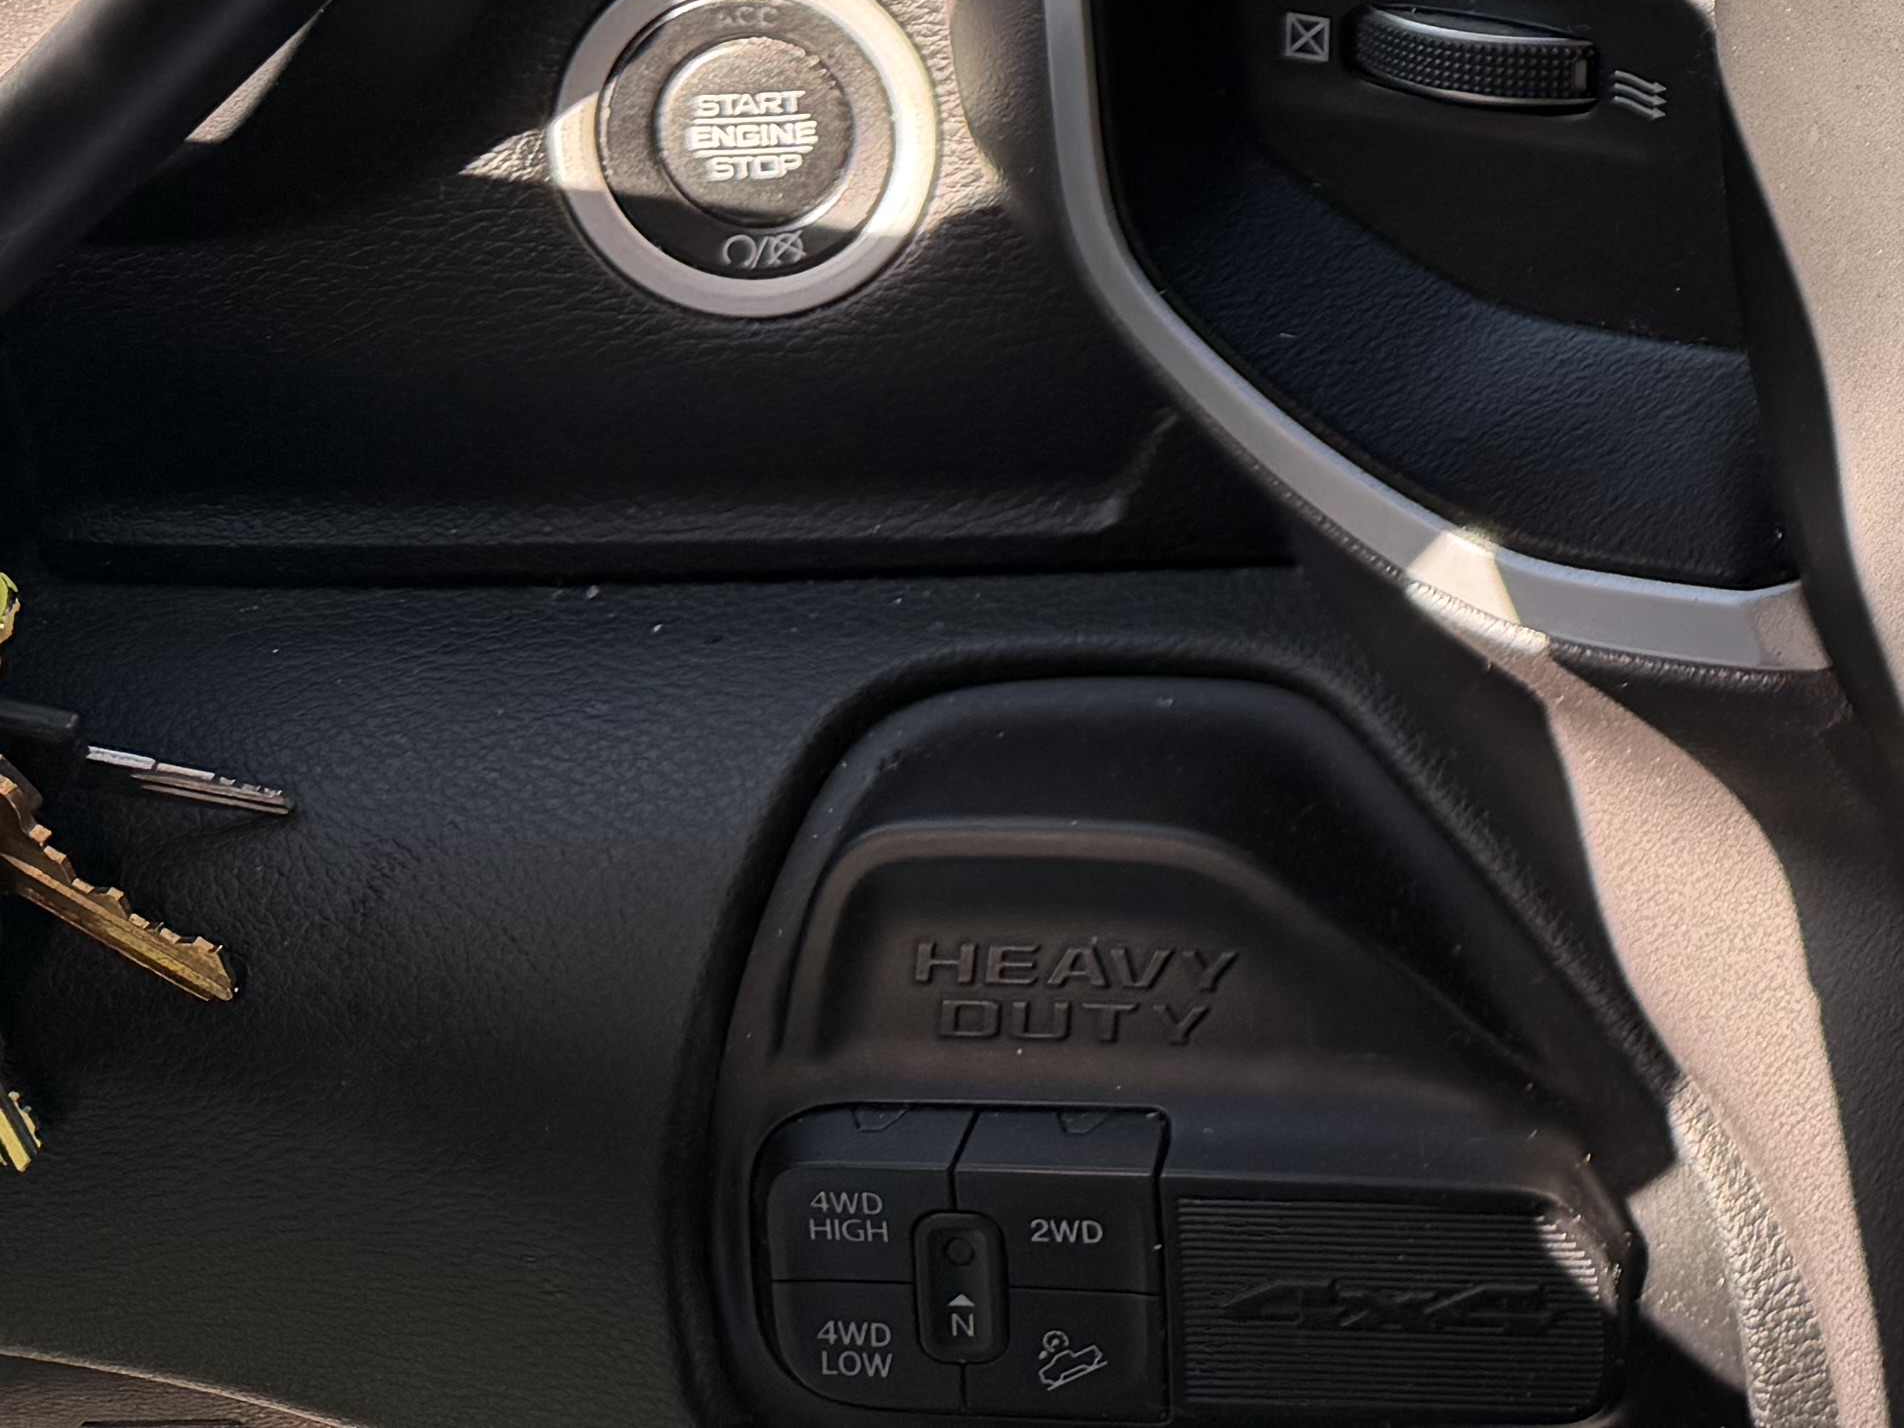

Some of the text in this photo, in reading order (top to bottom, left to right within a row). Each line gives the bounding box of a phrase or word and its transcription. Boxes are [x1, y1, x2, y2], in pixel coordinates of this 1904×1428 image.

[696, 90, 806, 117] START
[688, 120, 818, 150] ENGINE
[706, 154, 802, 181] STOP
[915, 943, 1238, 991] HEAVY
[939, 1000, 1209, 1045] DUTY
[810, 1191, 883, 1216] 4WD
[809, 1218, 889, 1243] HIGH
[1030, 1219, 1103, 1244] 2WD
[817, 1320, 892, 1347] 4WD
[951, 1312, 975, 1337] N
[821, 1350, 893, 1378] LOW
